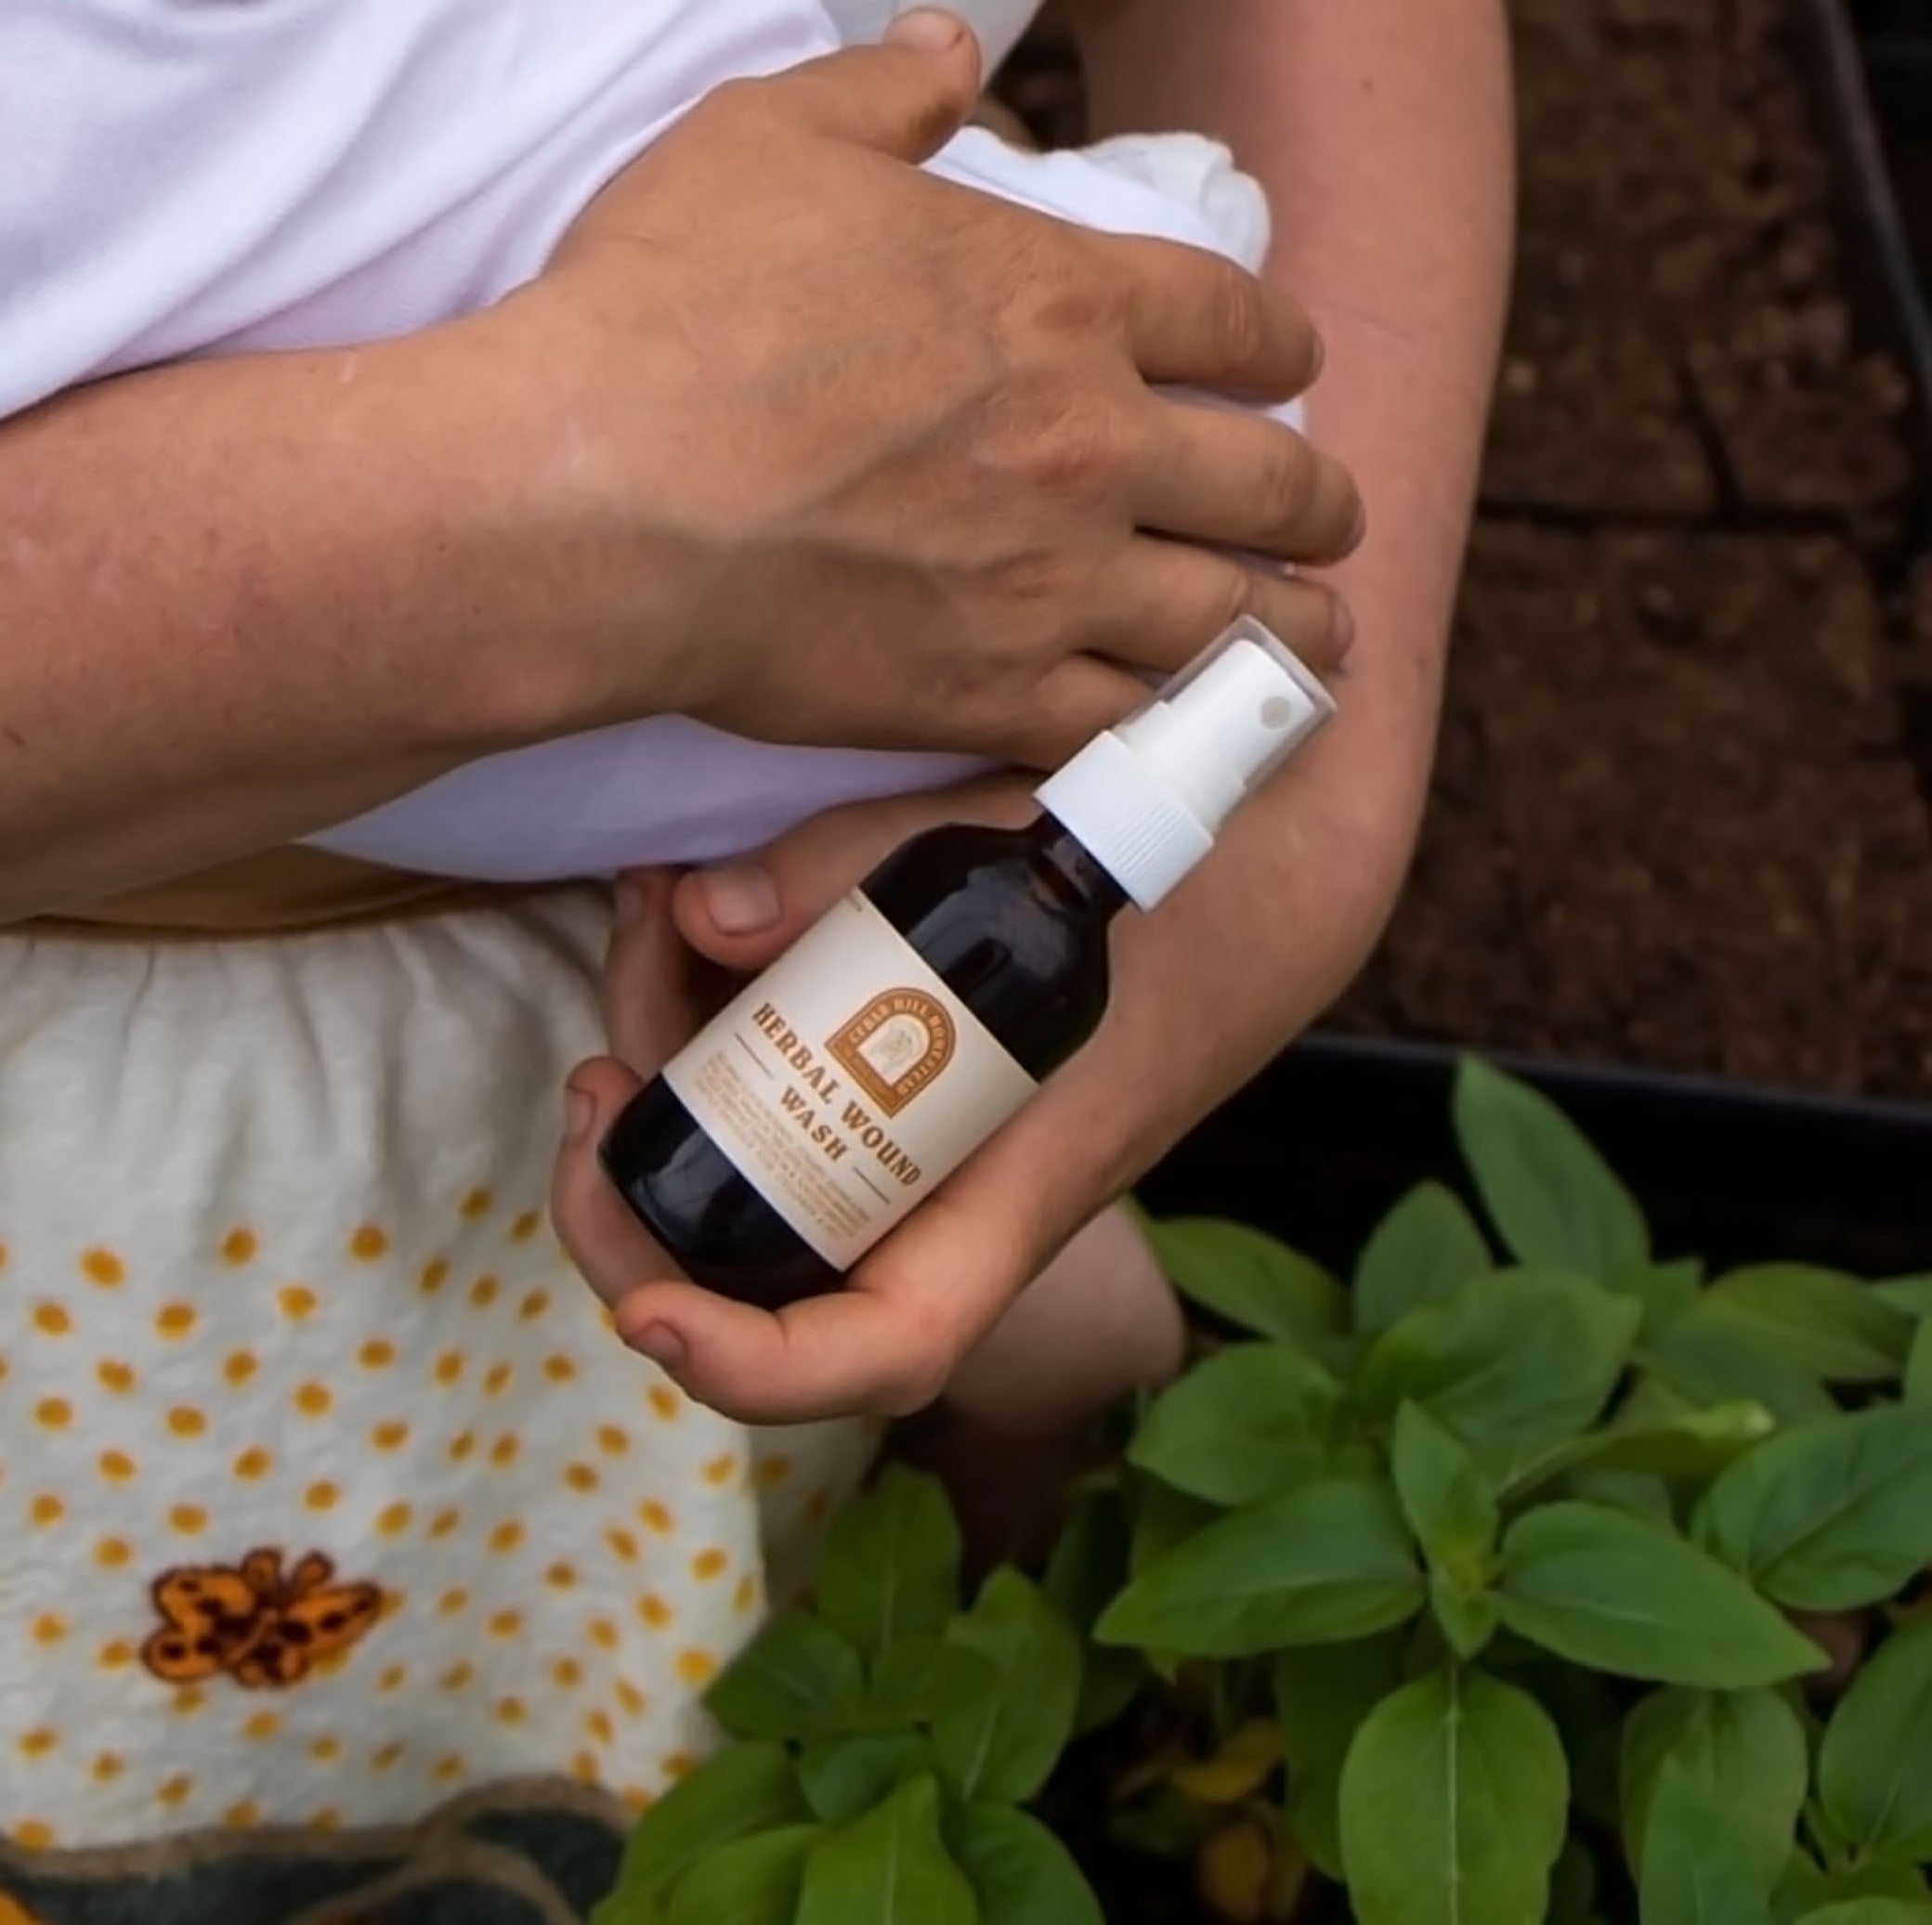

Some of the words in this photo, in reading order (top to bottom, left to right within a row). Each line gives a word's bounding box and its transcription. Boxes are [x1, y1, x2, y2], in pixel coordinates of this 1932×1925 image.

[751, 1002, 840, 1105] HERBAL
[840, 1099, 922, 1186] WOUND
[780, 1085, 849, 1162] WASH
